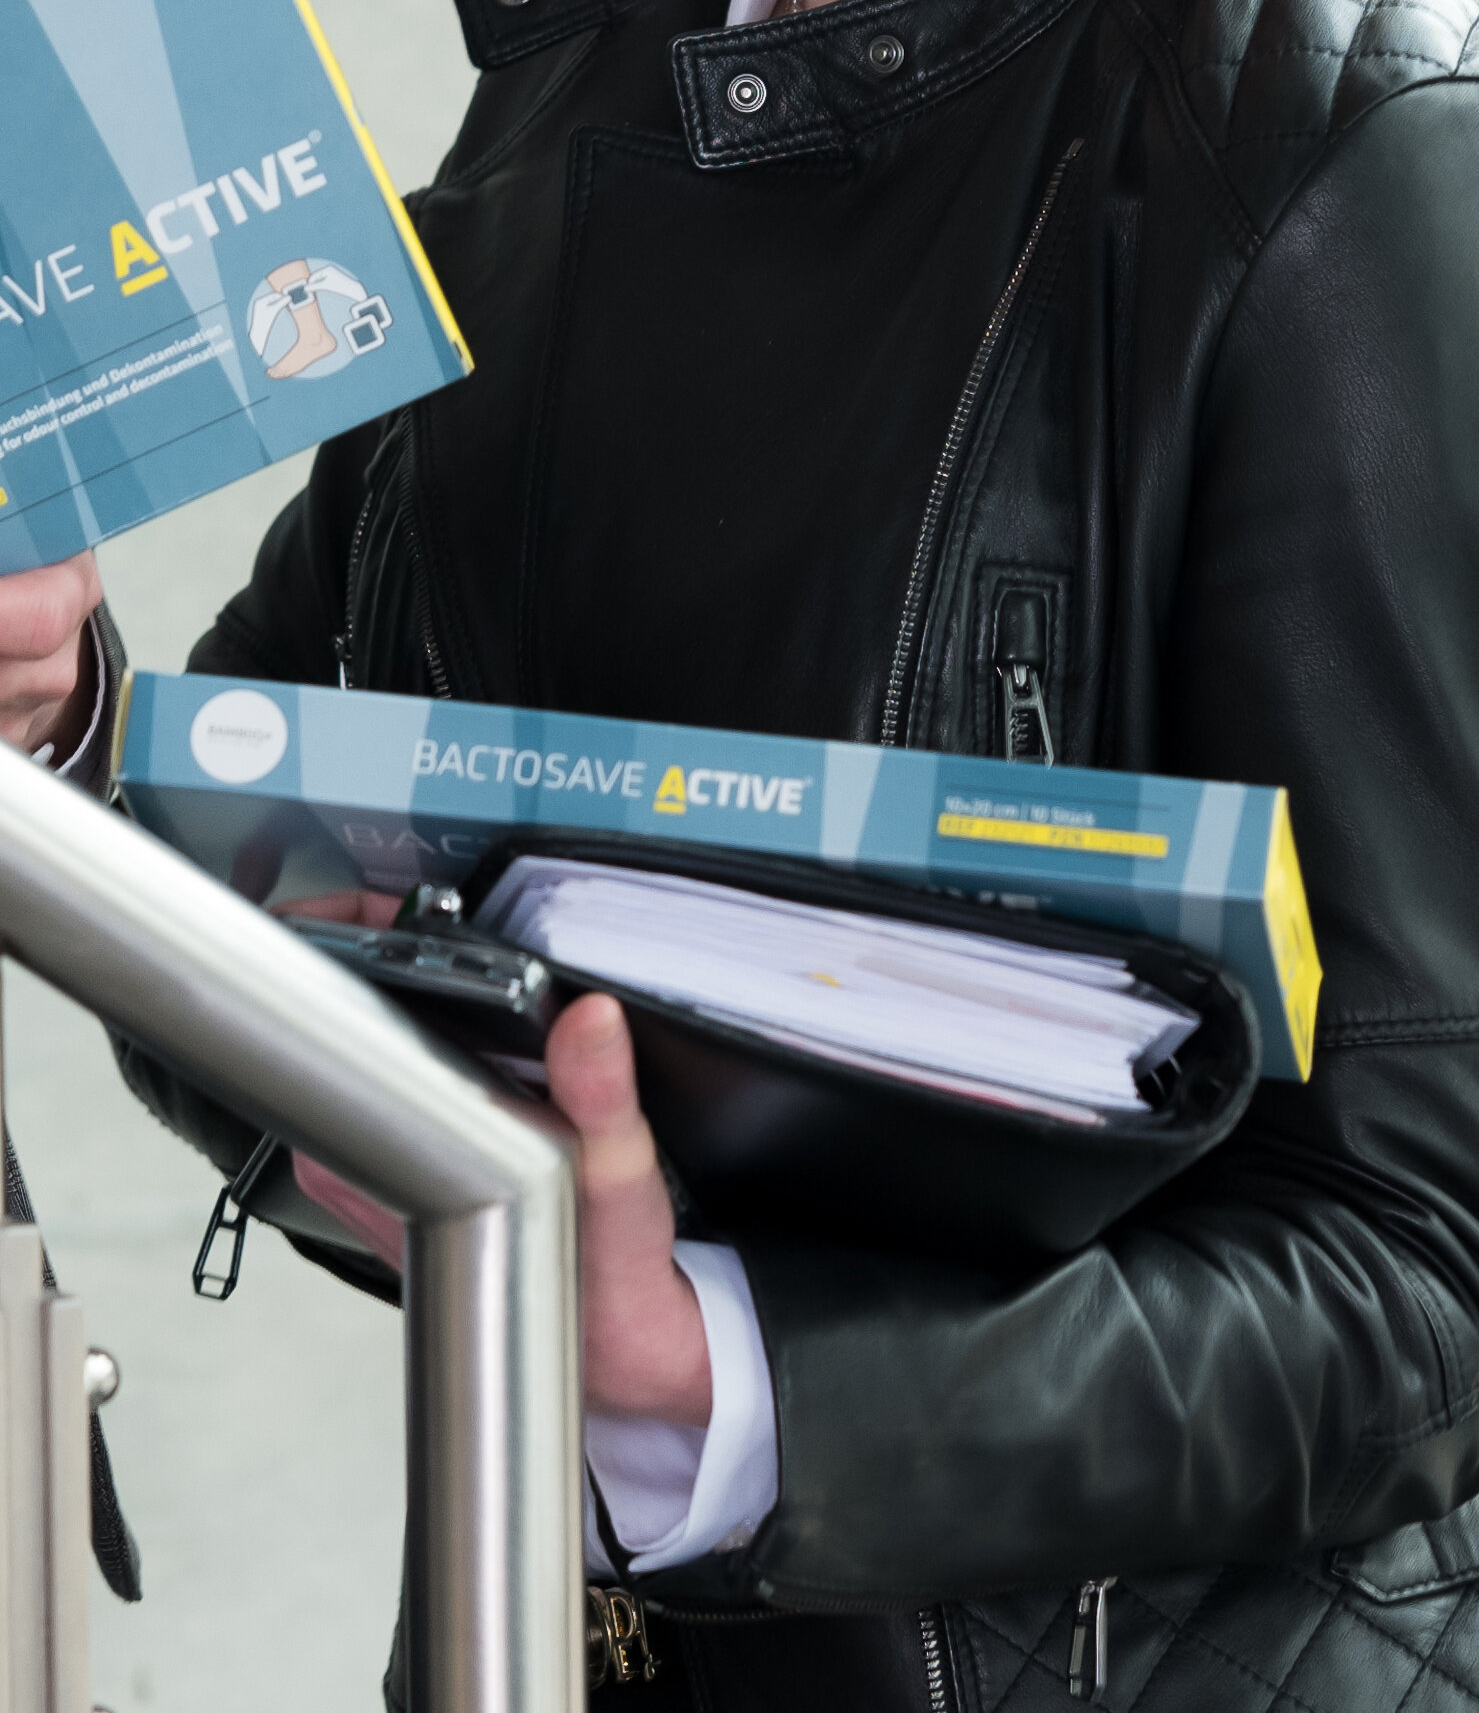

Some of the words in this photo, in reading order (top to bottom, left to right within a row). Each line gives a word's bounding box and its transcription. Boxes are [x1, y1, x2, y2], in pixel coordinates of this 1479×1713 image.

[2, 436, 23, 452] for
[23, 418, 60, 442] odour
[60, 395, 104, 425] control
[105, 383, 130, 406] and
[130, 338, 235, 394] decontamination
[82, 373, 109, 396] und
[109, 324, 224, 384] Dekontamination
[411, 738, 647, 798] BACTOSAVE
[653, 764, 804, 816] ACTIVE
